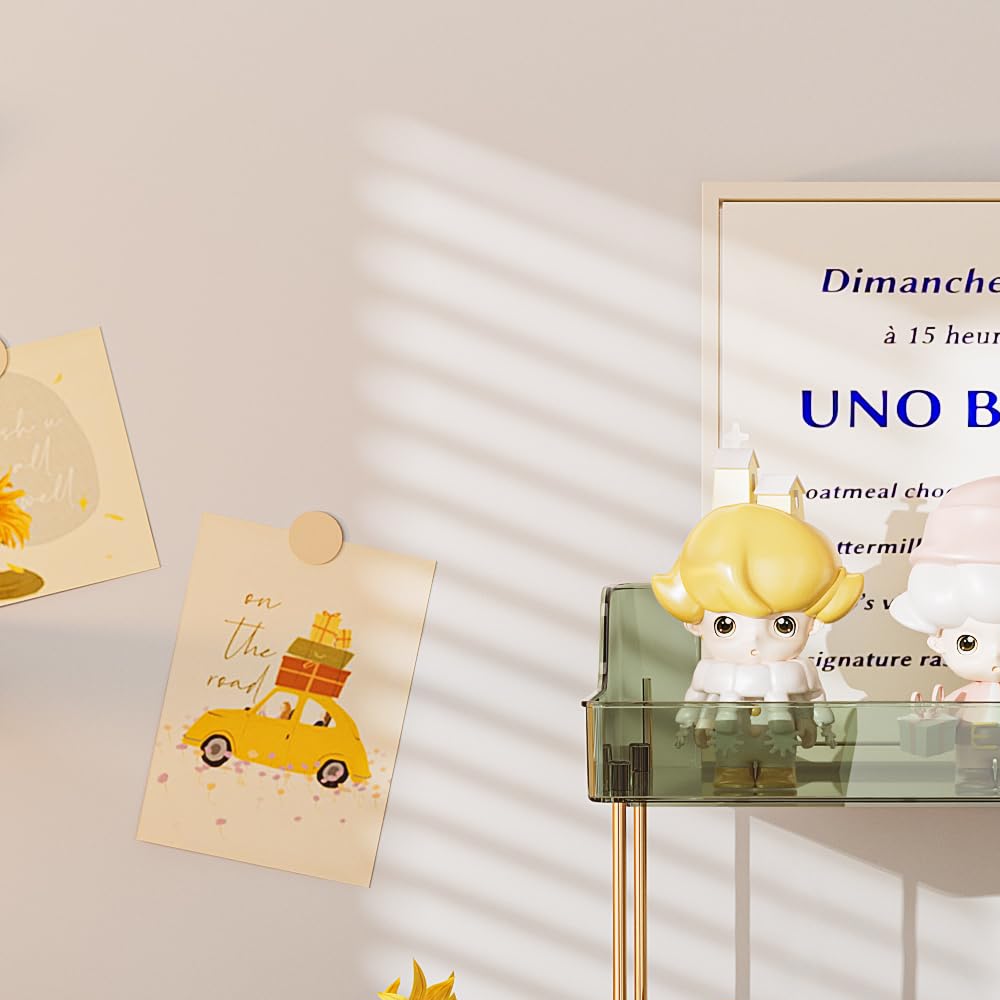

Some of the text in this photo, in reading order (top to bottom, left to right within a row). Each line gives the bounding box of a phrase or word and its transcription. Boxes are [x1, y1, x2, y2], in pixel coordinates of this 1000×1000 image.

[883, 325, 897, 345] à
[908, 326, 936, 345] 15
[800, 389, 942, 429] UNO
[805, 482, 898, 500] oatmeal
[904, 482, 952, 499] cho
[837, 538, 922, 555] ttermil
[224, 617, 278, 660] the
[919, 655, 949, 668] ra
